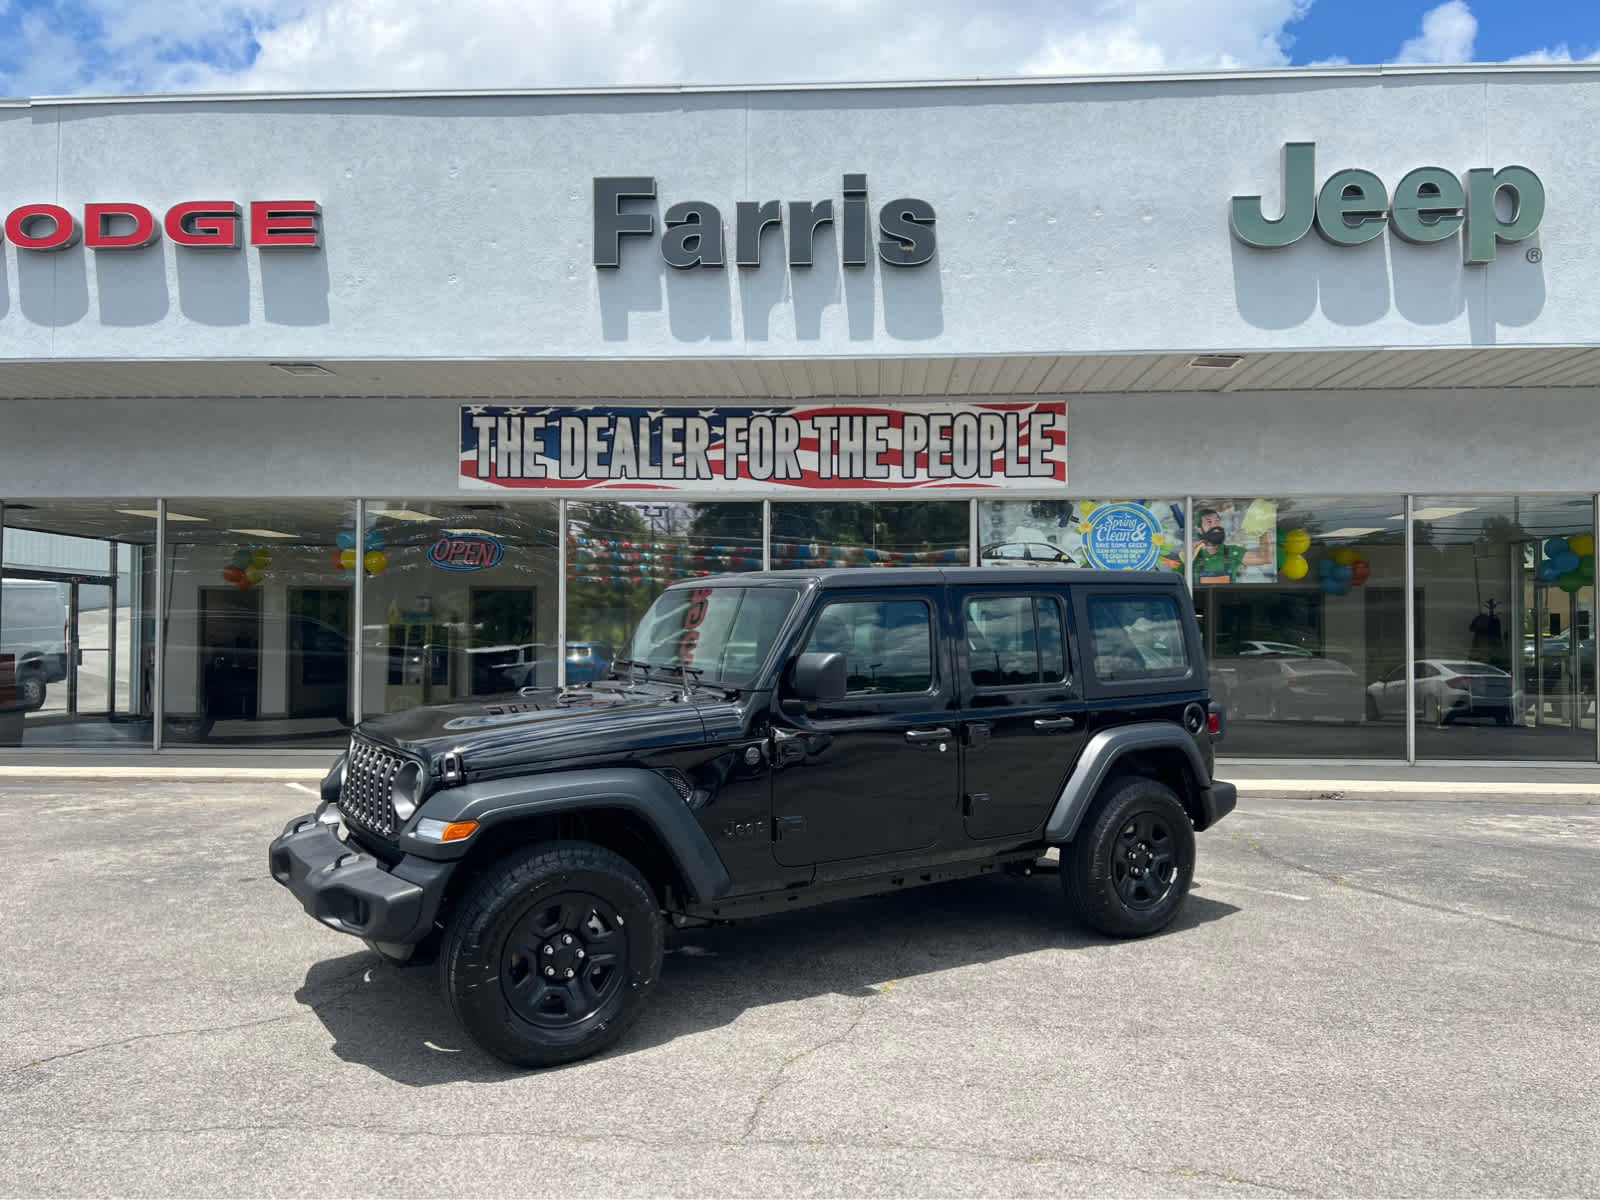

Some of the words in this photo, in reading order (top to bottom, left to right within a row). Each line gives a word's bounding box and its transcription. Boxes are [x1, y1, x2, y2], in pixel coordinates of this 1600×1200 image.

[0, 200, 321, 250] ODGE
[593, 173, 937, 269] Farris
[1229, 141, 1545, 265] Jeep
[471, 414, 548, 480] THE
[559, 414, 714, 480] DEALER
[723, 414, 803, 480] FOR
[812, 412, 890, 480] THE
[902, 411, 1056, 479] PEOPLE
[1095, 524, 1131, 542] Clean
[1131, 522, 1147, 542] &
[1104, 515, 1138, 532] Spring
[433, 538, 496, 568] OPEN
